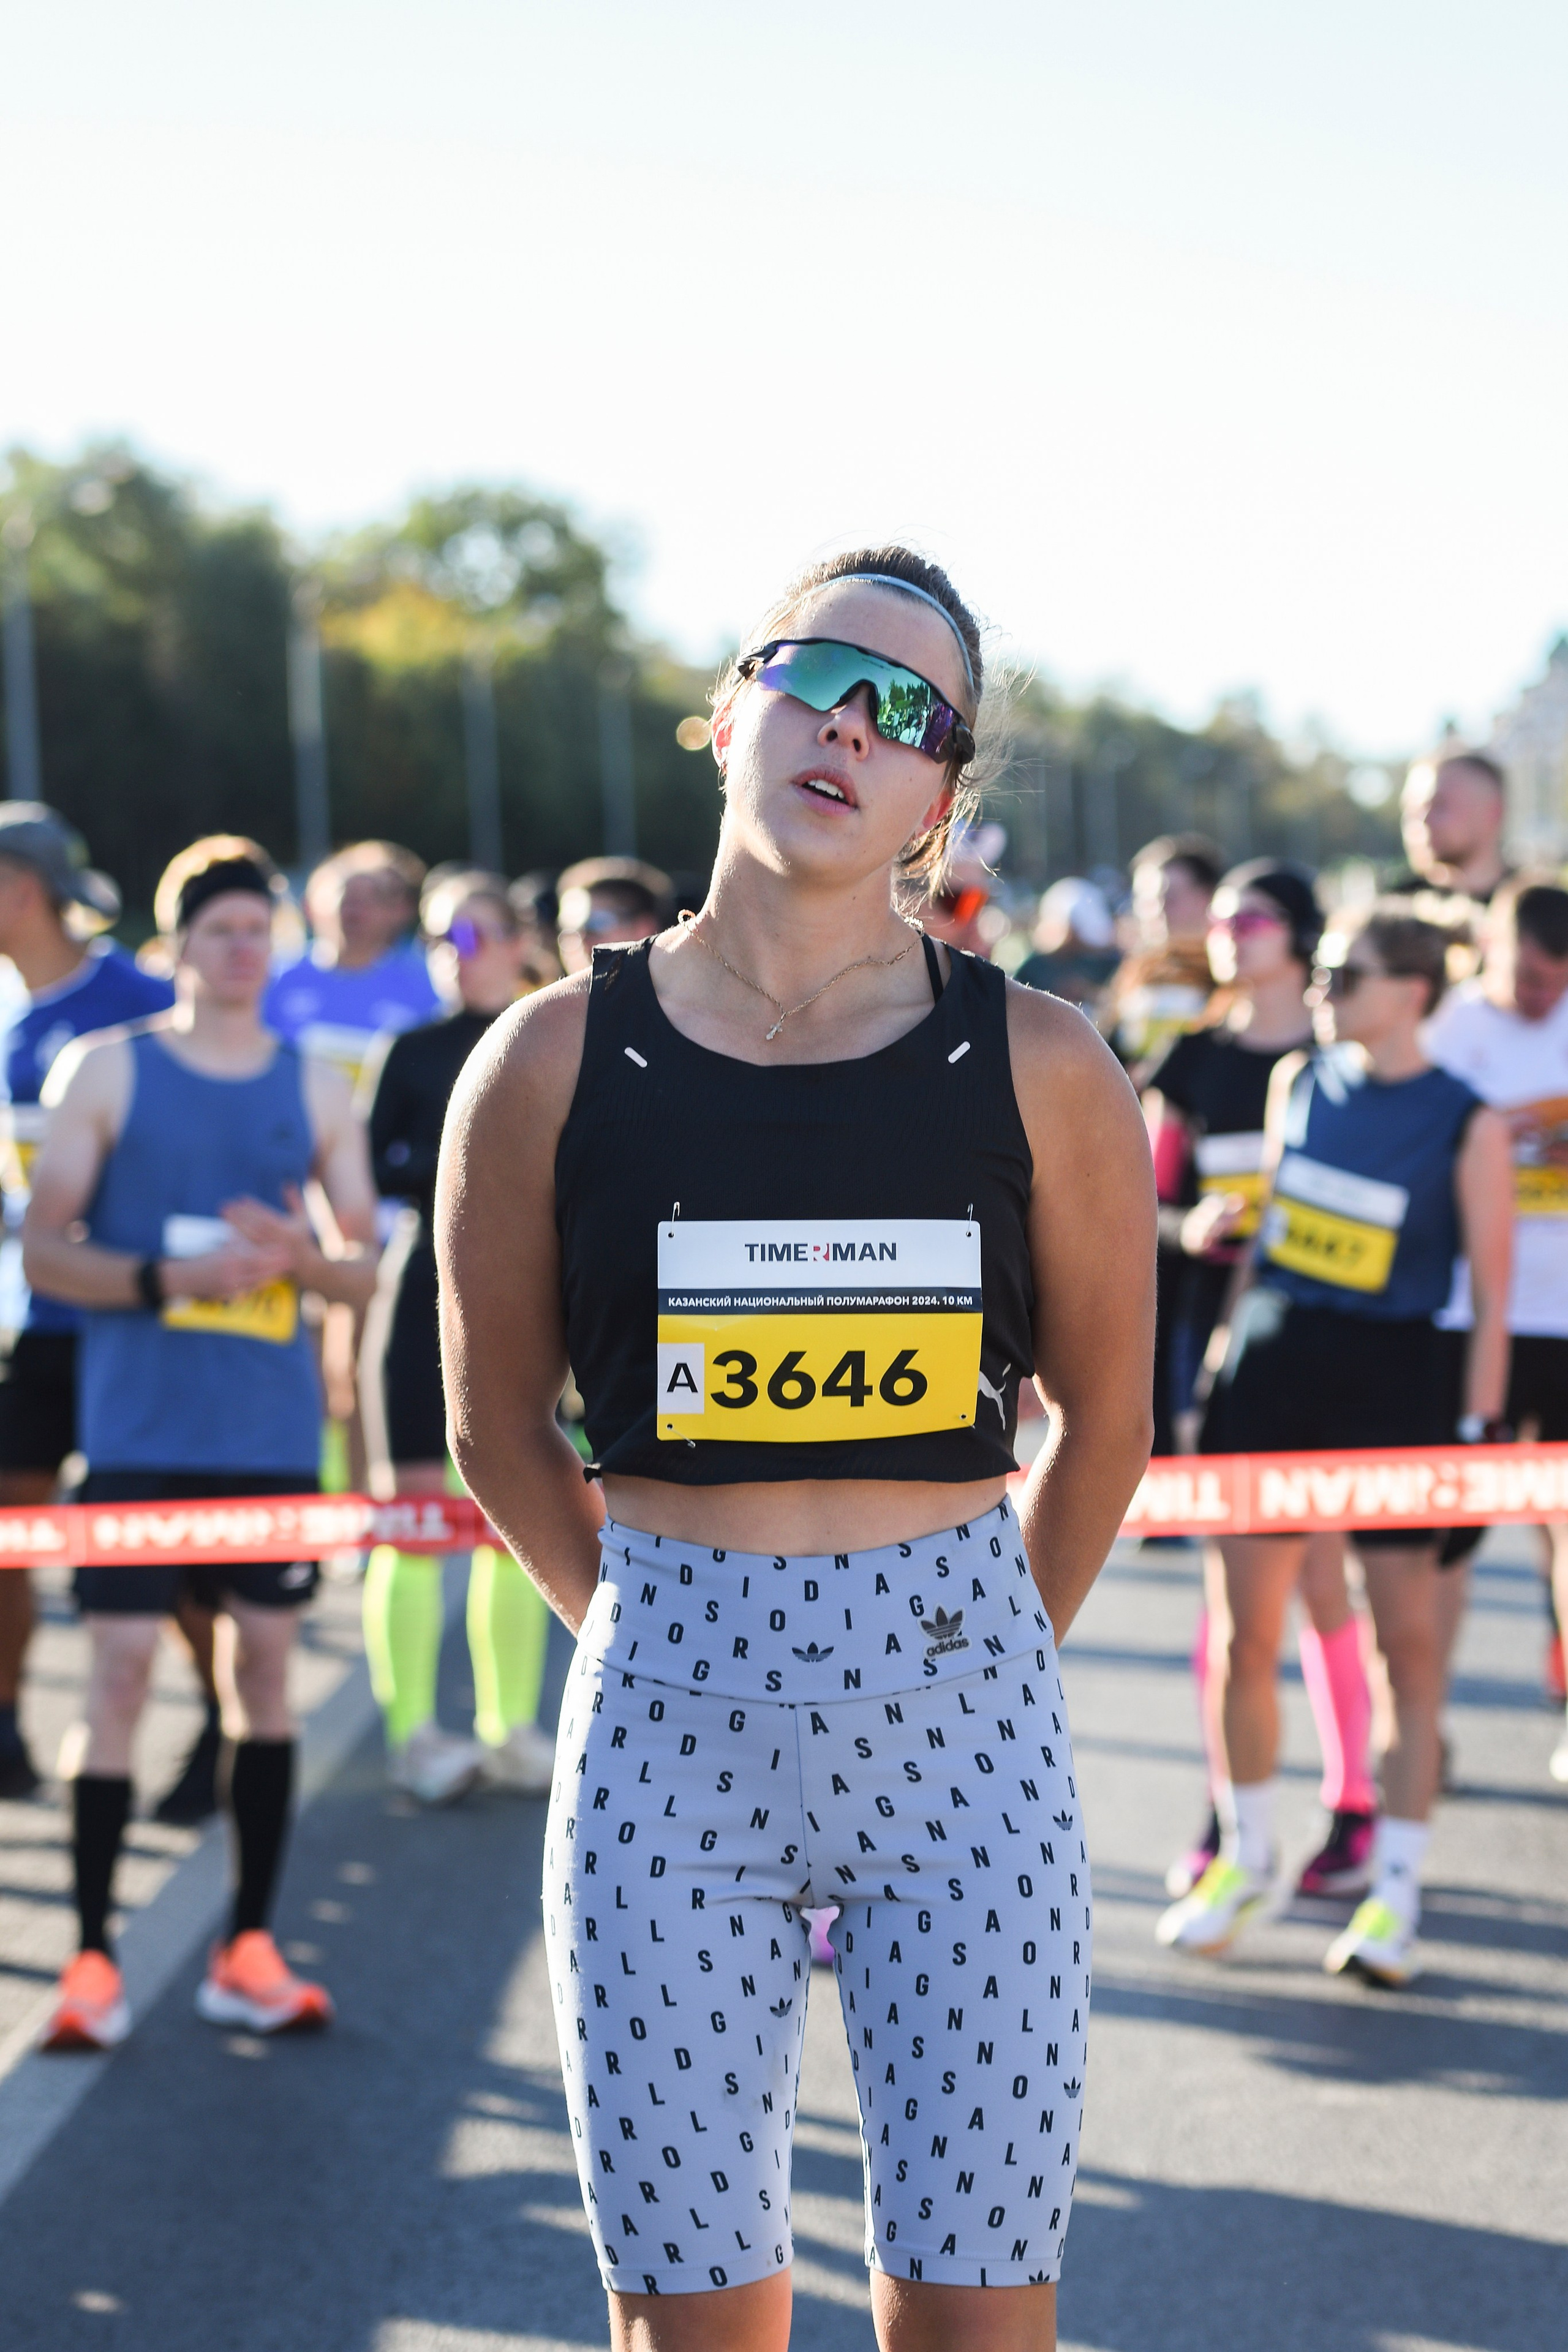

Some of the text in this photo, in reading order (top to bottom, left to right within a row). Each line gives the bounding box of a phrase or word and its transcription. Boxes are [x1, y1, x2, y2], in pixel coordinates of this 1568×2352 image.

[668, 1294, 973, 1308] КАЗАНСКИЙ НАЦИОНАЛЬНЫЙ ПОЛУМАРАФОН 2024. 10 КМ
[710, 1349, 928, 1410] 3646
[990, 1537, 1001, 1558] O
[680, 1564, 692, 1585] D
[936, 1556, 949, 1578] S
[1015, 1555, 1026, 1577] N
[641, 1583, 657, 1606] N
[805, 1580, 818, 1601] D
[876, 1573, 890, 1595] A
[973, 1578, 986, 1601] A
[705, 1600, 718, 1623] S
[910, 1595, 924, 1616] G
[1009, 1596, 1020, 1616] L
[770, 1610, 785, 1631] O
[1035, 1611, 1046, 1632] N
[668, 1623, 684, 1644] O
[886, 1633, 902, 1654] A
[733, 1637, 748, 1659] R
[927, 1638, 969, 1657] adidas
[984, 1635, 1005, 1656] N
[693, 1660, 710, 1681] G
[1036, 1650, 1045, 1671] D
[766, 1670, 782, 1692] S
[844, 1668, 861, 1689] N
[959, 1693, 975, 1714] L
[1022, 1684, 1035, 1706] A
[649, 1700, 664, 1722] O
[729, 1710, 745, 1732] G
[884, 1703, 903, 1724] N
[810, 1712, 829, 1735] A
[997, 1719, 1016, 1741] N
[1052, 1713, 1061, 1734] A
[611, 1726, 627, 1748] R
[680, 1734, 696, 1755] D
[854, 1738, 872, 1758] S
[926, 1728, 945, 1749] N
[974, 1753, 993, 1774] O
[1041, 1746, 1056, 1767] R
[639, 1762, 651, 1783] L
[717, 1771, 733, 1792] S
[903, 1762, 922, 1782] S
[832, 1774, 850, 1795] A
[1020, 1779, 1039, 1801] N
[594, 1787, 609, 1810] R
[664, 1795, 676, 1817] L
[875, 1796, 894, 1817] G
[951, 1787, 970, 1808] A
[750, 1808, 769, 1830] N
[1002, 1813, 1020, 1834] L
[619, 1822, 635, 1844] O
[700, 1830, 717, 1851] G
[925, 1820, 947, 1841] N
[857, 1831, 876, 1853] A
[1040, 1842, 1054, 1864] N
[585, 1851, 597, 1874] R
[781, 1845, 797, 1864] S
[902, 1855, 920, 1872] S
[971, 1846, 990, 1868] N
[650, 1856, 666, 1877] D
[835, 1865, 856, 1884] N
[948, 1879, 963, 1901] S
[1018, 1875, 1033, 1898] O
[1071, 1874, 1078, 1896] R
[616, 1886, 628, 1909] L
[692, 1888, 704, 1909] R
[586, 1918, 598, 1941] R
[730, 1915, 744, 1937] N
[918, 1910, 930, 1933] G
[986, 1910, 1000, 1932] A
[1050, 1908, 1060, 1931] N
[650, 1920, 664, 1942] L
[846, 1931, 853, 1953] D
[771, 1939, 782, 1960] A
[889, 1941, 902, 1963] A
[952, 1942, 966, 1966] S
[1023, 1941, 1036, 1964] O
[1074, 1941, 1079, 1964] R
[571, 1950, 578, 1972] A
[621, 1952, 636, 1975] L
[698, 1950, 713, 1972] S
[793, 1959, 801, 1981] N
[661, 1985, 677, 2007] L
[741, 1975, 755, 1997] N
[916, 1974, 929, 1996] G
[983, 1976, 998, 1998] A
[1050, 1976, 1060, 1999] N
[594, 1985, 608, 2008] R
[711, 2011, 726, 2033] G
[888, 2003, 899, 2024] A
[948, 2008, 963, 2030] N
[1022, 2009, 1033, 2032] L
[1072, 2009, 1079, 2032] A
[577, 2018, 587, 2040] R
[630, 2017, 646, 2040] O
[864, 2027, 872, 2049] N
[674, 2048, 692, 2070] D
[912, 2037, 924, 2059] S
[977, 2042, 993, 2064] N
[1047, 2043, 1058, 2065] N
[605, 2051, 622, 2075] R
[886, 2063, 895, 2085] A
[725, 2073, 739, 2095] S
[942, 2071, 956, 2094] S
[1012, 2075, 1028, 2099] O
[589, 2085, 600, 2107] A
[649, 2083, 665, 2105] L
[763, 2092, 772, 2114] N
[905, 2098, 918, 2120] G
[968, 2108, 984, 2130] A
[619, 2117, 637, 2140] R
[690, 2111, 707, 2132] L
[1039, 2111, 1054, 2133] N
[739, 2132, 753, 2152] G
[881, 2124, 889, 2146] A
[662, 2146, 680, 2168] O
[931, 2135, 947, 2158] N
[1005, 2143, 1017, 2165] L
[1062, 2143, 1069, 2165] A
[599, 2150, 615, 2173] R
[896, 2160, 908, 2182] S
[639, 2182, 659, 2203] R
[710, 2171, 729, 2193] D
[956, 2171, 974, 2193] N
[1028, 2176, 1043, 2198] N
[759, 2190, 771, 2210] S
[875, 2184, 881, 2206] A
[690, 2209, 709, 2229] L
[919, 2198, 933, 2220] S
[988, 2206, 1005, 2228] O
[1049, 2208, 1060, 2230] R
[622, 2214, 639, 2236] A
[887, 2221, 896, 2242] G
[735, 2231, 751, 2250] L
[940, 2234, 956, 2255] A
[1011, 2240, 1028, 2261] N
[605, 2245, 619, 2265] D
[663, 2243, 684, 2263] R
[775, 2245, 783, 2264] G
[709, 2266, 727, 2286] O
[910, 2258, 922, 2280] N
